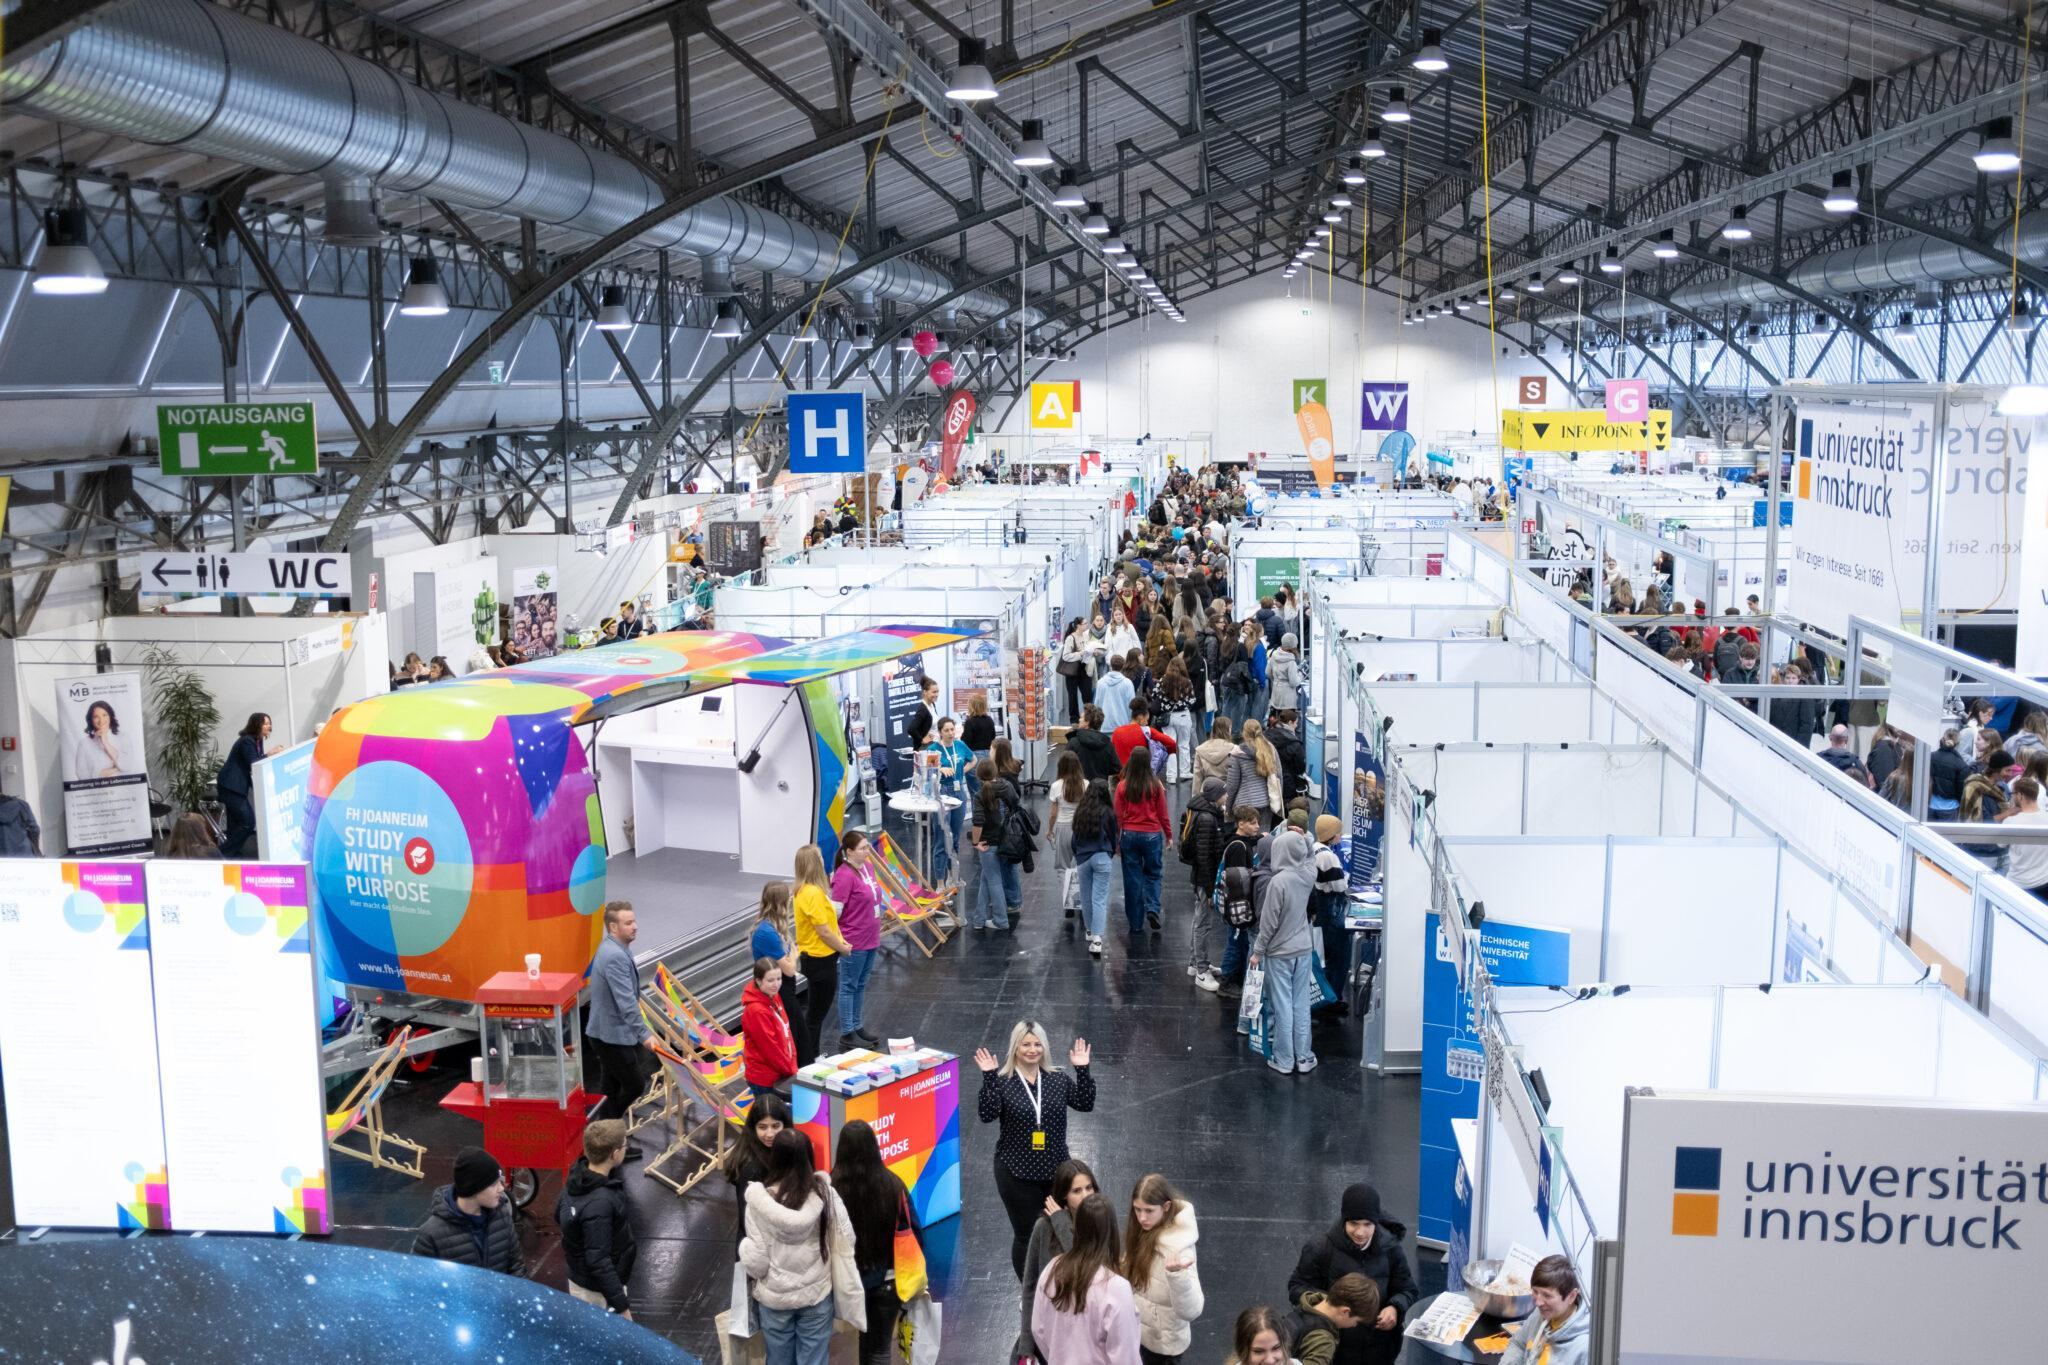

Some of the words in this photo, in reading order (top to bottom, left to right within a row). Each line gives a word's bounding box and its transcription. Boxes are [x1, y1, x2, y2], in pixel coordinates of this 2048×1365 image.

[1300, 385, 1319, 406] K
[1526, 381, 1541, 400] S
[1614, 388, 1639, 414] G
[167, 406, 306, 425] NOTAUSGANG
[1037, 392, 1067, 420] A
[1365, 391, 1407, 421] W
[803, 408, 850, 457] H
[1818, 422, 1904, 473] universität
[1816, 463, 1893, 519] innsbruck
[268, 558, 339, 589] WC
[1868, 568, 1884, 588] 1669
[69, 687, 90, 698] MB
[345, 807, 360, 821] FH
[361, 809, 429, 829] JOANNEUM
[1353, 817, 1361, 826] ES
[1361, 819, 1372, 830] UM
[344, 826, 404, 851] STUDY
[1352, 826, 1367, 838] DICH
[344, 850, 393, 875] WITH
[345, 874, 431, 903] PURPOSE
[358, 961, 453, 983] www.fh-joanneum.at
[900, 1087, 910, 1099] FH
[868, 1112, 896, 1131] TUDY
[1745, 1151, 2048, 1205] universität
[1743, 1195, 2023, 1250] innsbruck
